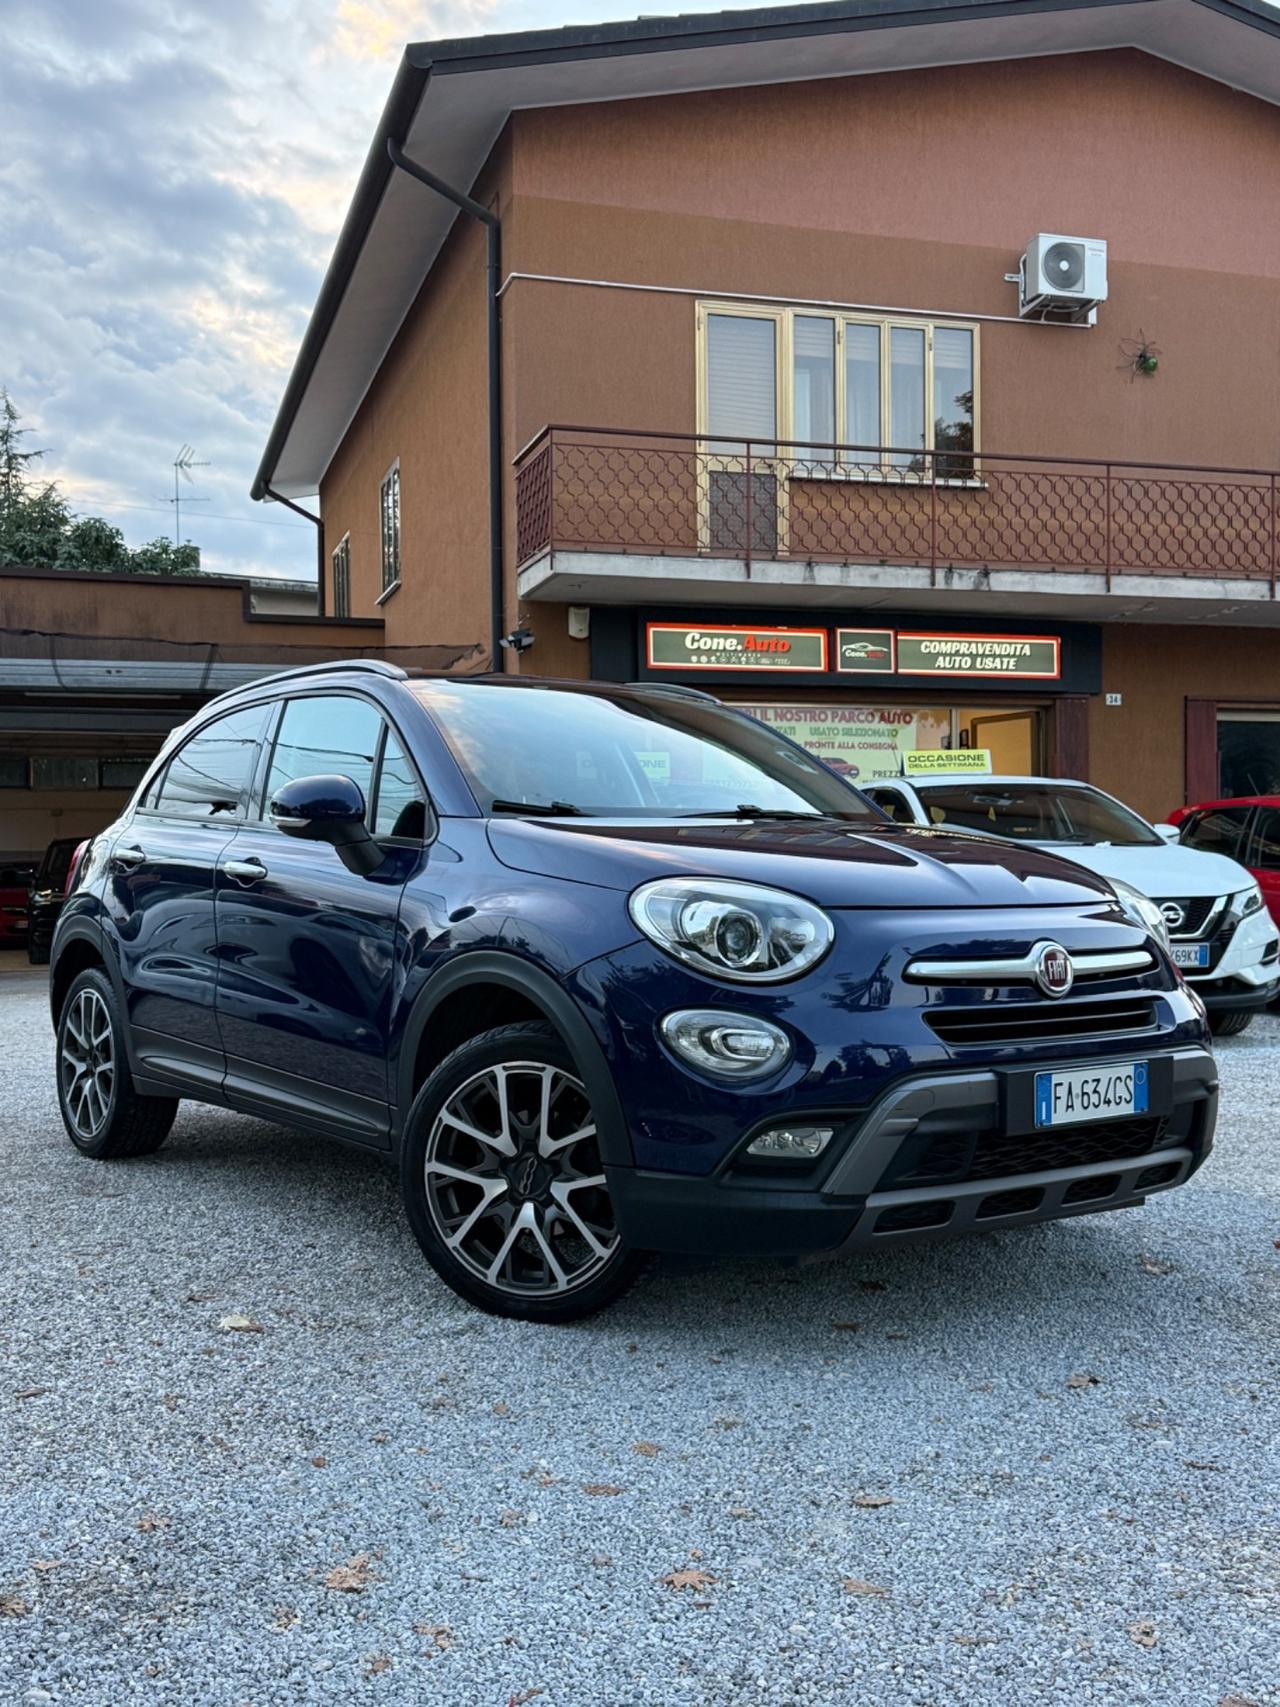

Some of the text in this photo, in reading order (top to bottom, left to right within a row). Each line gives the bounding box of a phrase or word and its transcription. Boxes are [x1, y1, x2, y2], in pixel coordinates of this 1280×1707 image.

[685, 632, 790, 652] Cone.Auto
[920, 641, 1031, 656] COMPRAVENDITA
[935, 656, 1017, 669] AUTO USATE
[774, 709, 828, 723] NOSTRO
[831, 710, 875, 724] PARCO
[878, 711, 913, 725] AUTO
[809, 726, 840, 737] USATO
[804, 741, 898, 751] PRONTE ALLA CONSEGNA
[907, 754, 985, 763] OCCASIONE
[1048, 959, 1066, 980] FIAT
